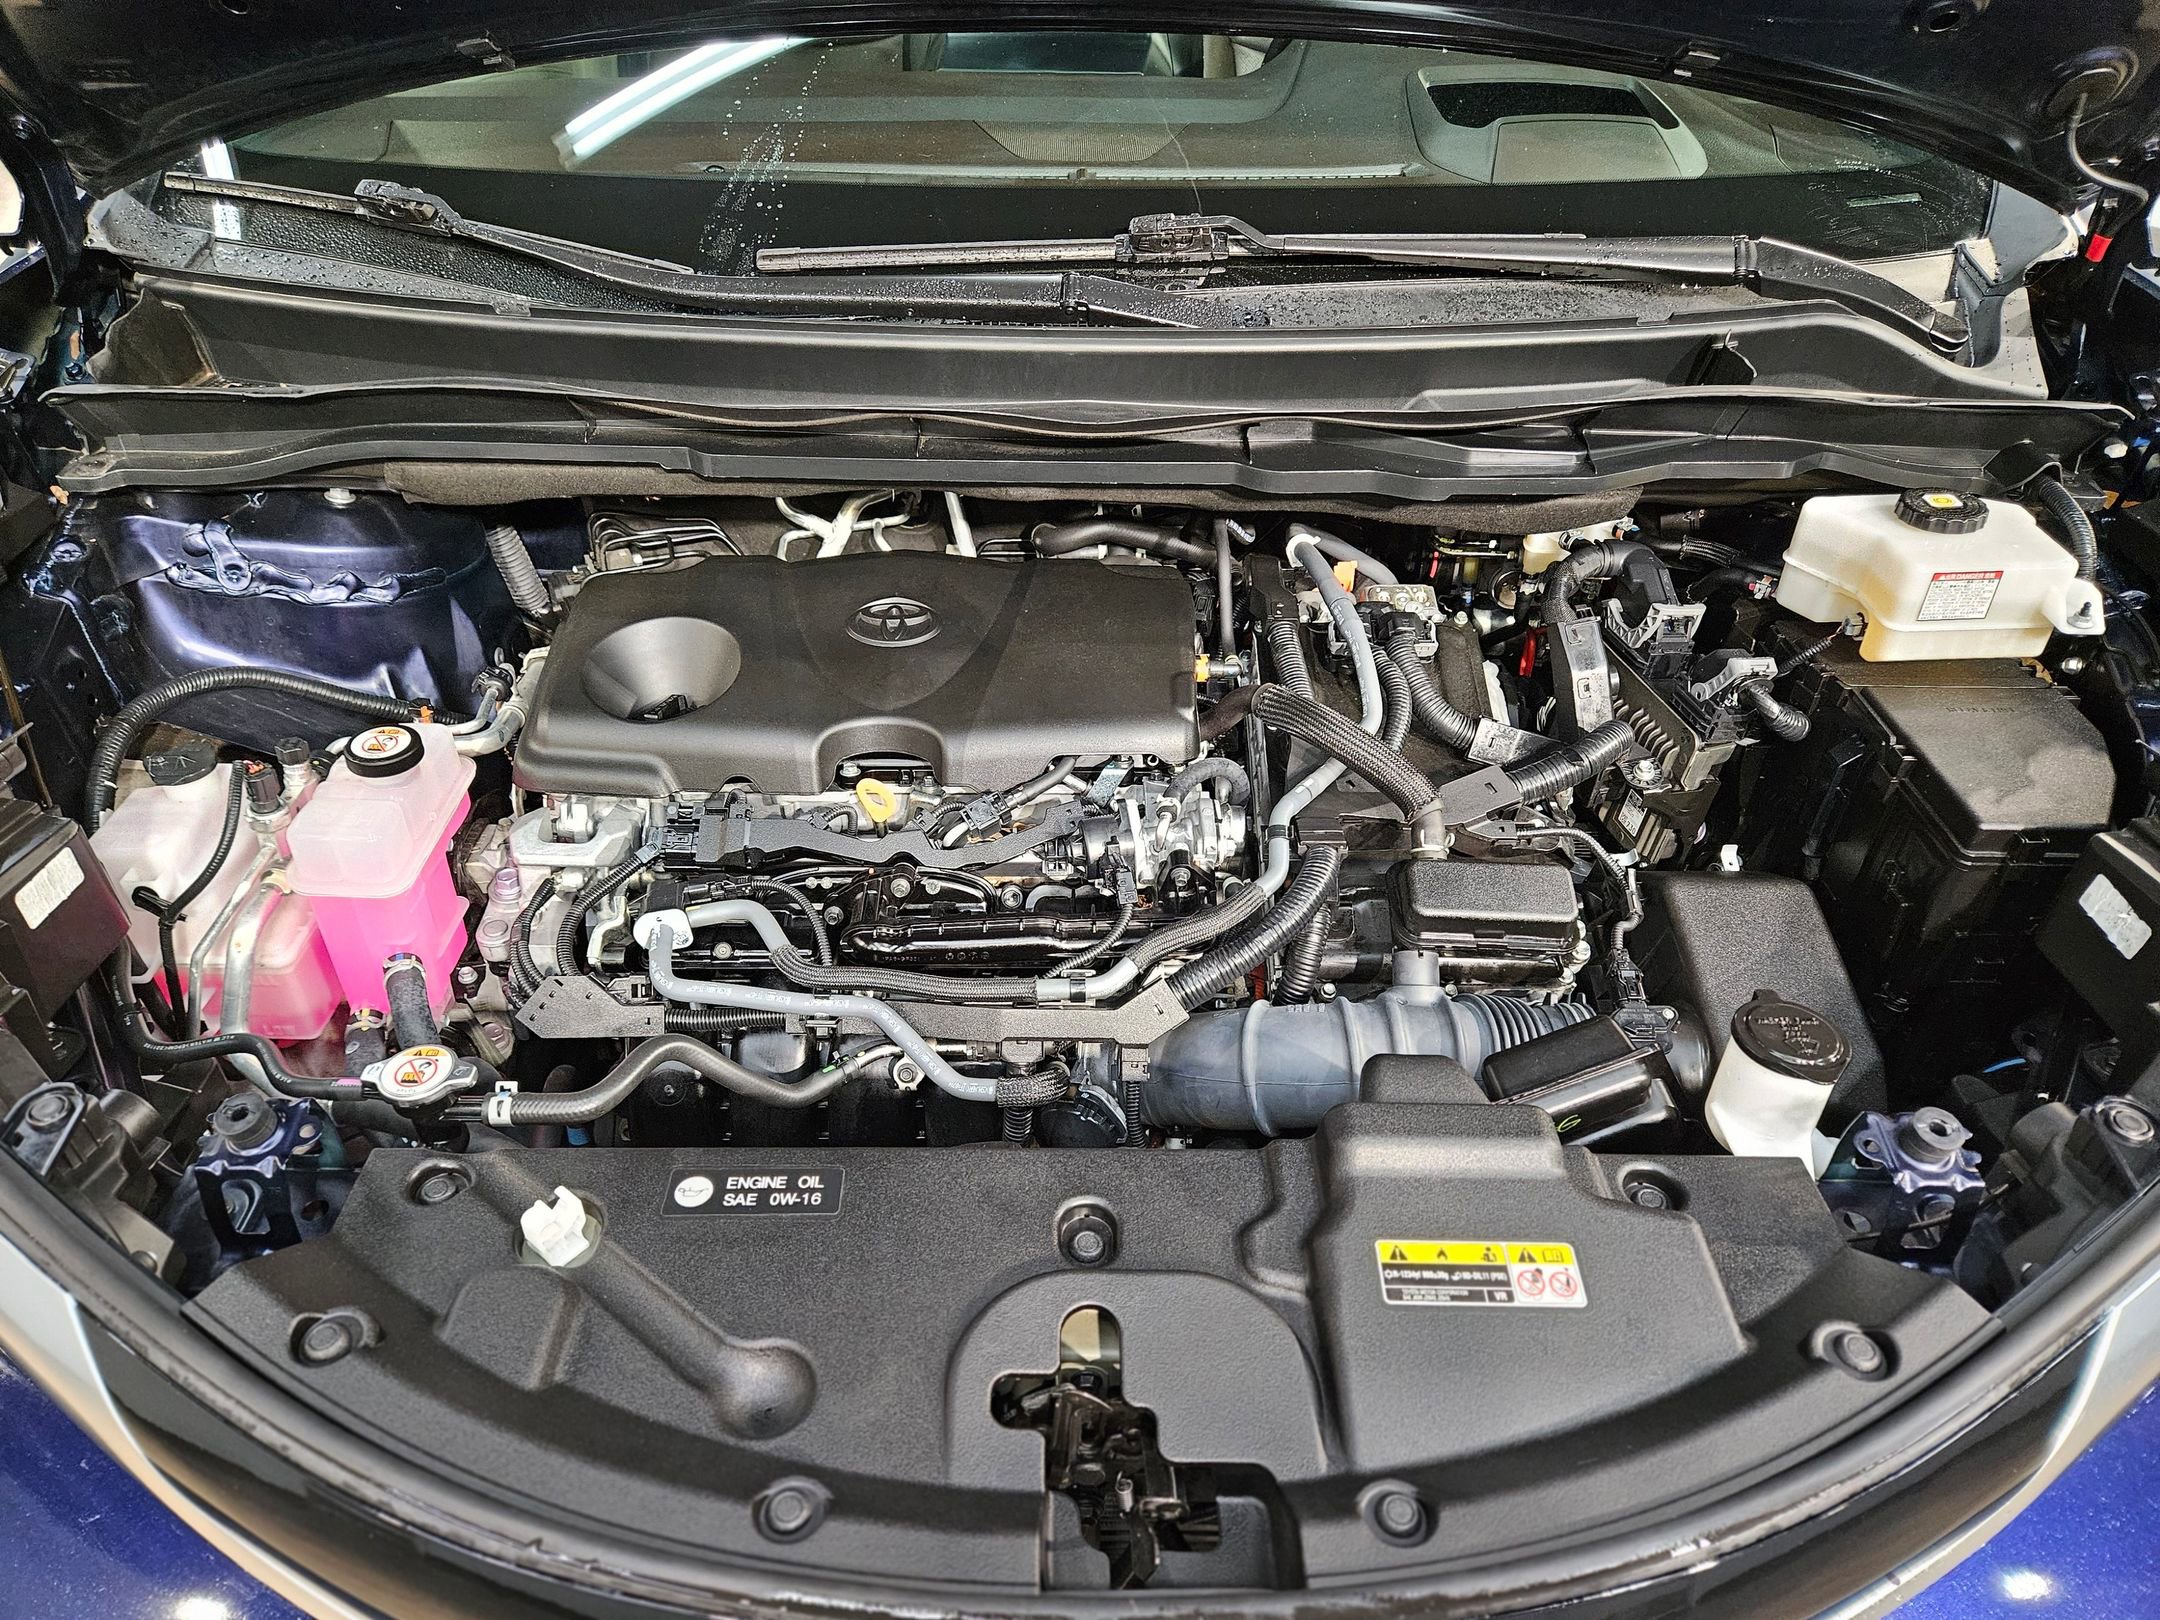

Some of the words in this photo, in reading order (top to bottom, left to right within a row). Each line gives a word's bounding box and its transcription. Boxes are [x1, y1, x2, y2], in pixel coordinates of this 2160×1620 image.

[726, 1176, 788, 1190] ENGINE
[797, 1175, 824, 1189] OIL
[722, 1193, 758, 1207] SAE
[769, 1192, 822, 1206] 0W-16
